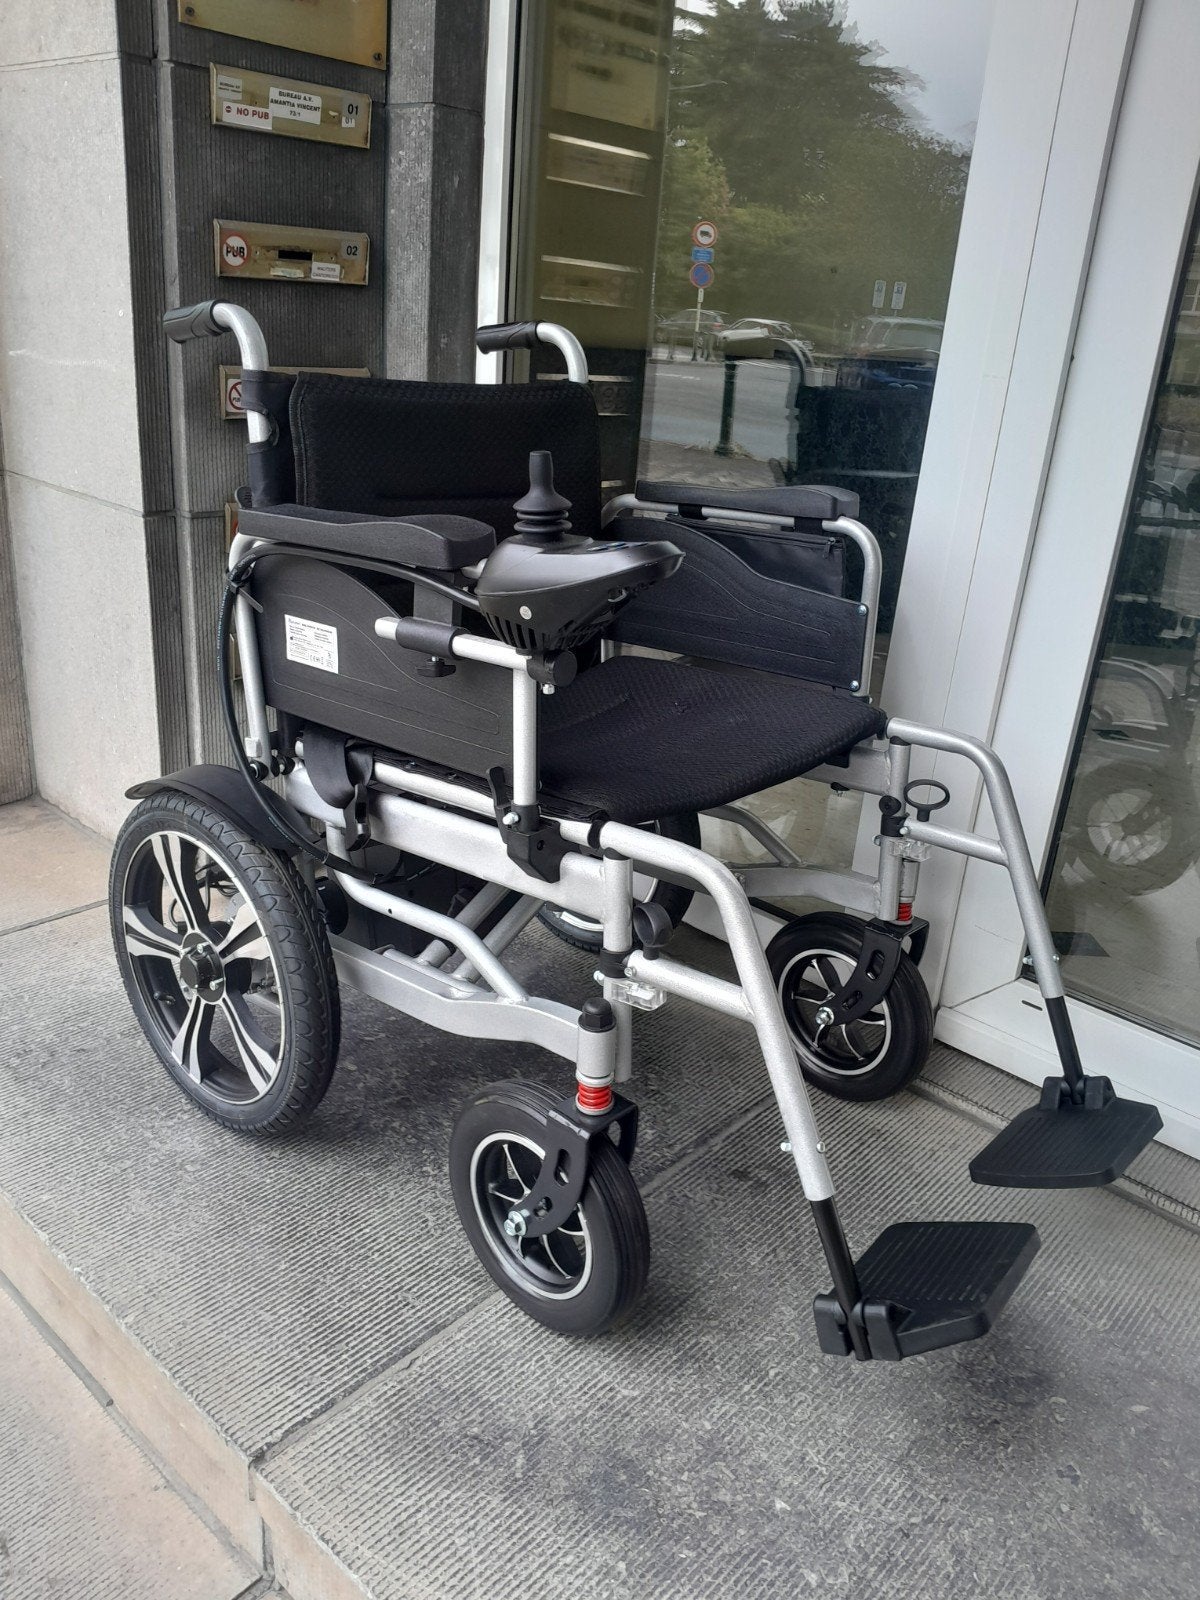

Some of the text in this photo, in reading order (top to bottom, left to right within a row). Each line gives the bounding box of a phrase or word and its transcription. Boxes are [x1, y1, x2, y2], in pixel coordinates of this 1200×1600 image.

[278, 91, 302, 100] BUREAU
[270, 98, 320, 112] AMANTIA VINCENT
[347, 103, 359, 116] 01
[236, 107, 270, 120] NO PUB
[226, 246, 245, 258] PUB
[346, 245, 358, 256] 02
